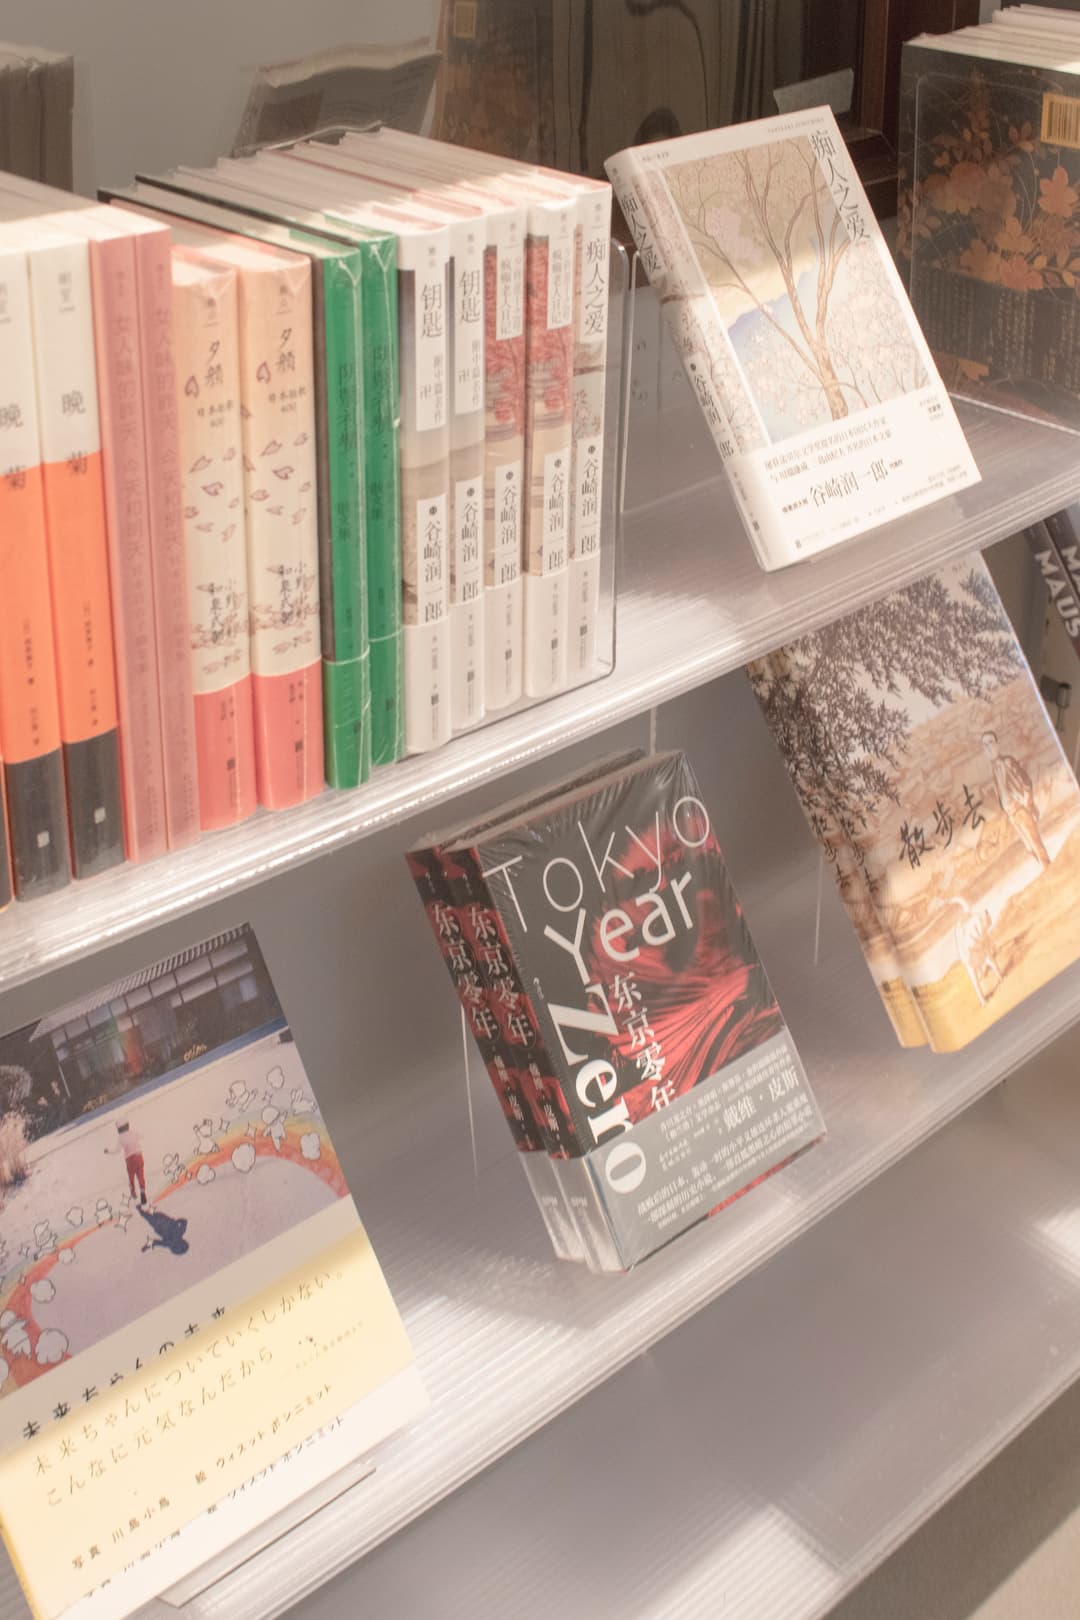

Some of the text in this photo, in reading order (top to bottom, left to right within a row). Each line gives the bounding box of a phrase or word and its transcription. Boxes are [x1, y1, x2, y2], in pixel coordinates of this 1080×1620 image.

[811, 130, 870, 241] 痴人之爱
[420, 282, 443, 340] 钥匙
[459, 268, 482, 325] 钥匙
[585, 238, 607, 338] 痴人之爱
[548, 474, 565, 571] 谷崎润一郎
[581, 458, 599, 555] 谷崎润一郎
[809, 458, 889, 508] 谷崎润一郎
[424, 513, 443, 624] 谷崎润一郎
[461, 501, 480, 602] 谷崎润一郎
[501, 485, 518, 585] 谷崎润一郎
[1034, 550, 1080, 638] MAUS
[899, 784, 986, 870] 散步去
[433, 903, 499, 1040] 东京零年
[470, 903, 535, 1047] 东京零年
[543, 871, 694, 986] Year
[547, 983, 647, 1194] Zero
[722, 1064, 800, 1132] 戴维·皮斯
